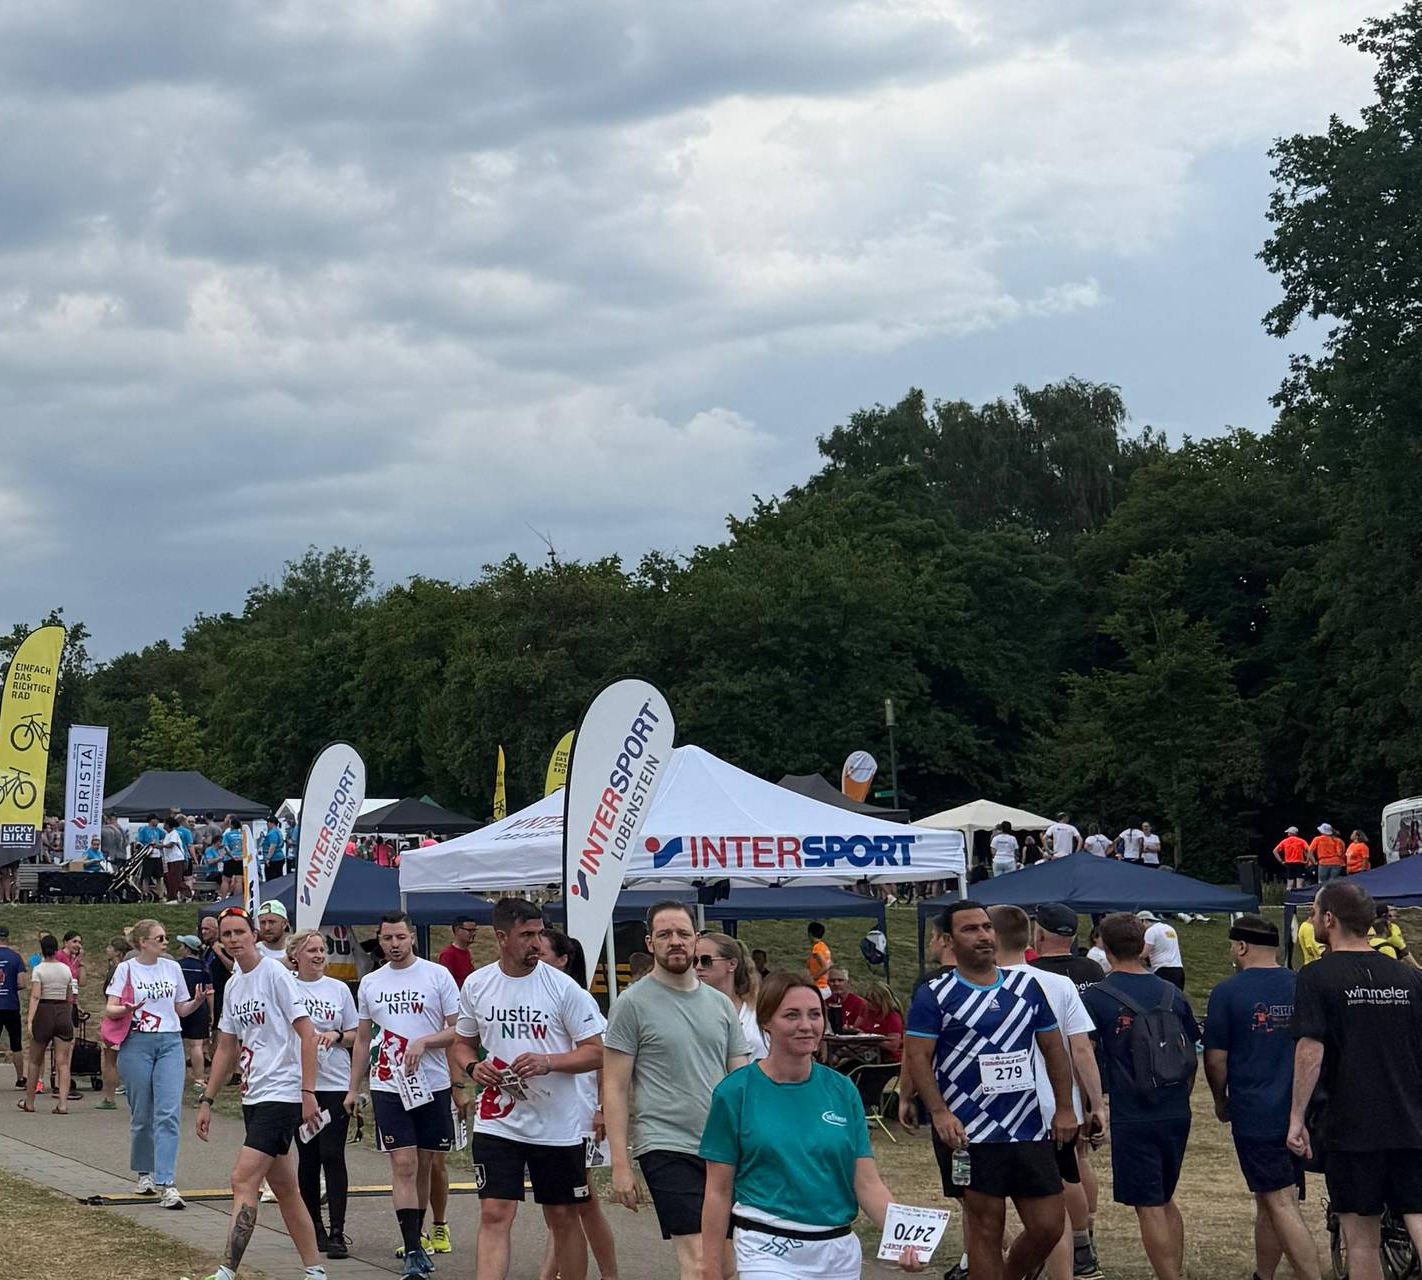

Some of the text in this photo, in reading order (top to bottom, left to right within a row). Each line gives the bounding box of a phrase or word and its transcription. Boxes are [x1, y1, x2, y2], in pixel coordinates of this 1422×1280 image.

[14, 672, 32, 681] DAS
[16, 663, 51, 675] EINFACH
[12, 681, 51, 694] RICHTIGE
[12, 691, 30, 700] RAD
[77, 749, 93, 813] BRISTA
[579, 701, 660, 876] INTERSPORT
[611, 754, 660, 862] LOBENSTEIN
[3, 825, 33, 833] LUCKY
[305, 764, 356, 888] INTERSPORT
[2, 833, 32, 841] BIKE
[324, 797, 356, 878] LOBENSTEIN
[690, 835, 915, 868] INTERSPORT
[147, 988, 174, 1000] NRW
[388, 1002, 424, 1015] NRW
[239, 1011, 266, 1027] NRW
[501, 1022, 548, 1040] NRW
[994, 1065, 1022, 1080] 279
[407, 1072, 424, 1100] 275
[894, 1223, 936, 1243] 2470
